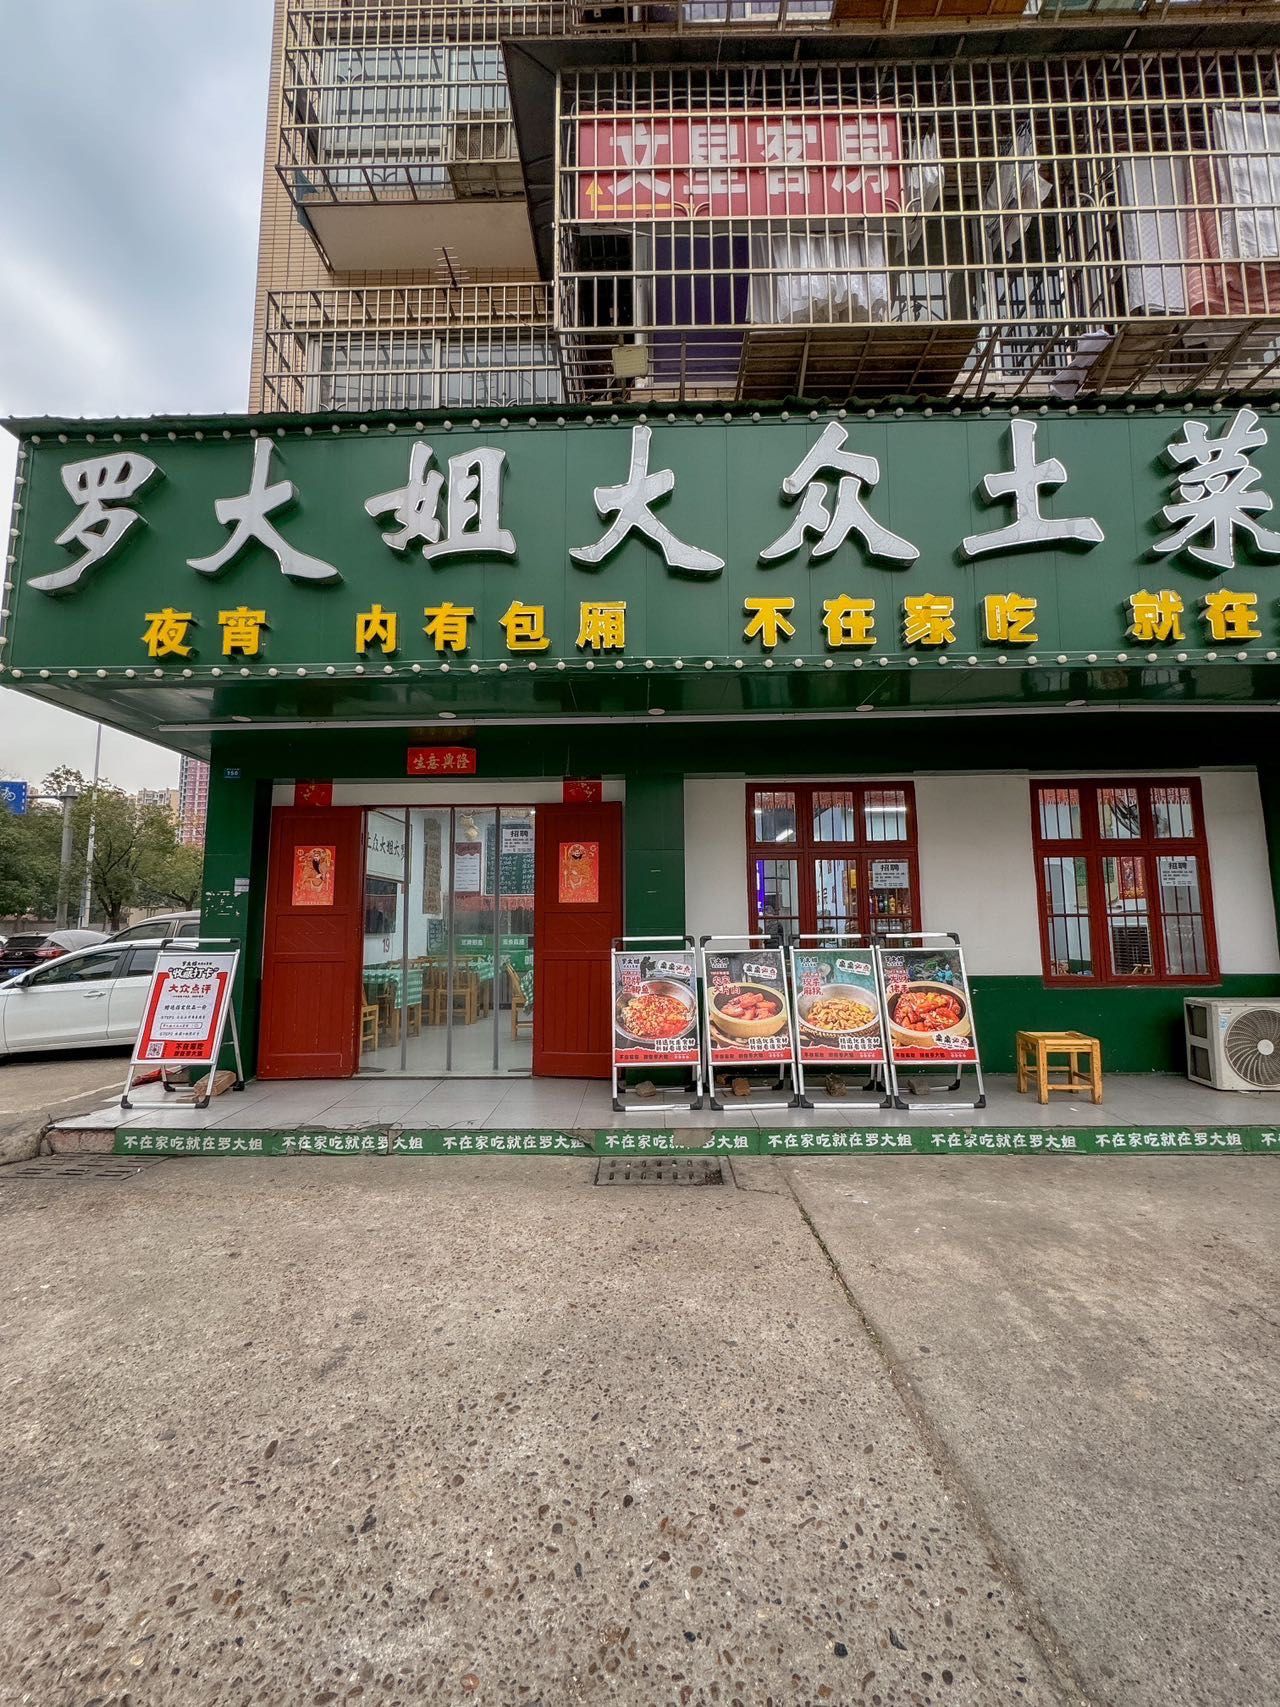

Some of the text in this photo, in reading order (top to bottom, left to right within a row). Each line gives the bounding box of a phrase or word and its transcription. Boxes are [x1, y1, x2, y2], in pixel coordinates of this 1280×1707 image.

[142, 588, 1262, 658] 夜宵 内有包厢 不在家吃 就在
[510, 830, 529, 838] 招聘
[880, 864, 900, 872] 招聘
[1168, 861, 1188, 870] 招聘
[168, 983, 212, 994] 大众点评
[123, 1135, 263, 1151] 不在家吃就在罗大姐
[767, 1133, 912, 1148] 不在家吃就在罗大姐
[931, 1133, 1077, 1148] 不在家吃就在罗大姐
[1095, 1132, 1242, 1148] 不在家吃就在罗大姐
[1261, 1132, 1280, 1147] 不
